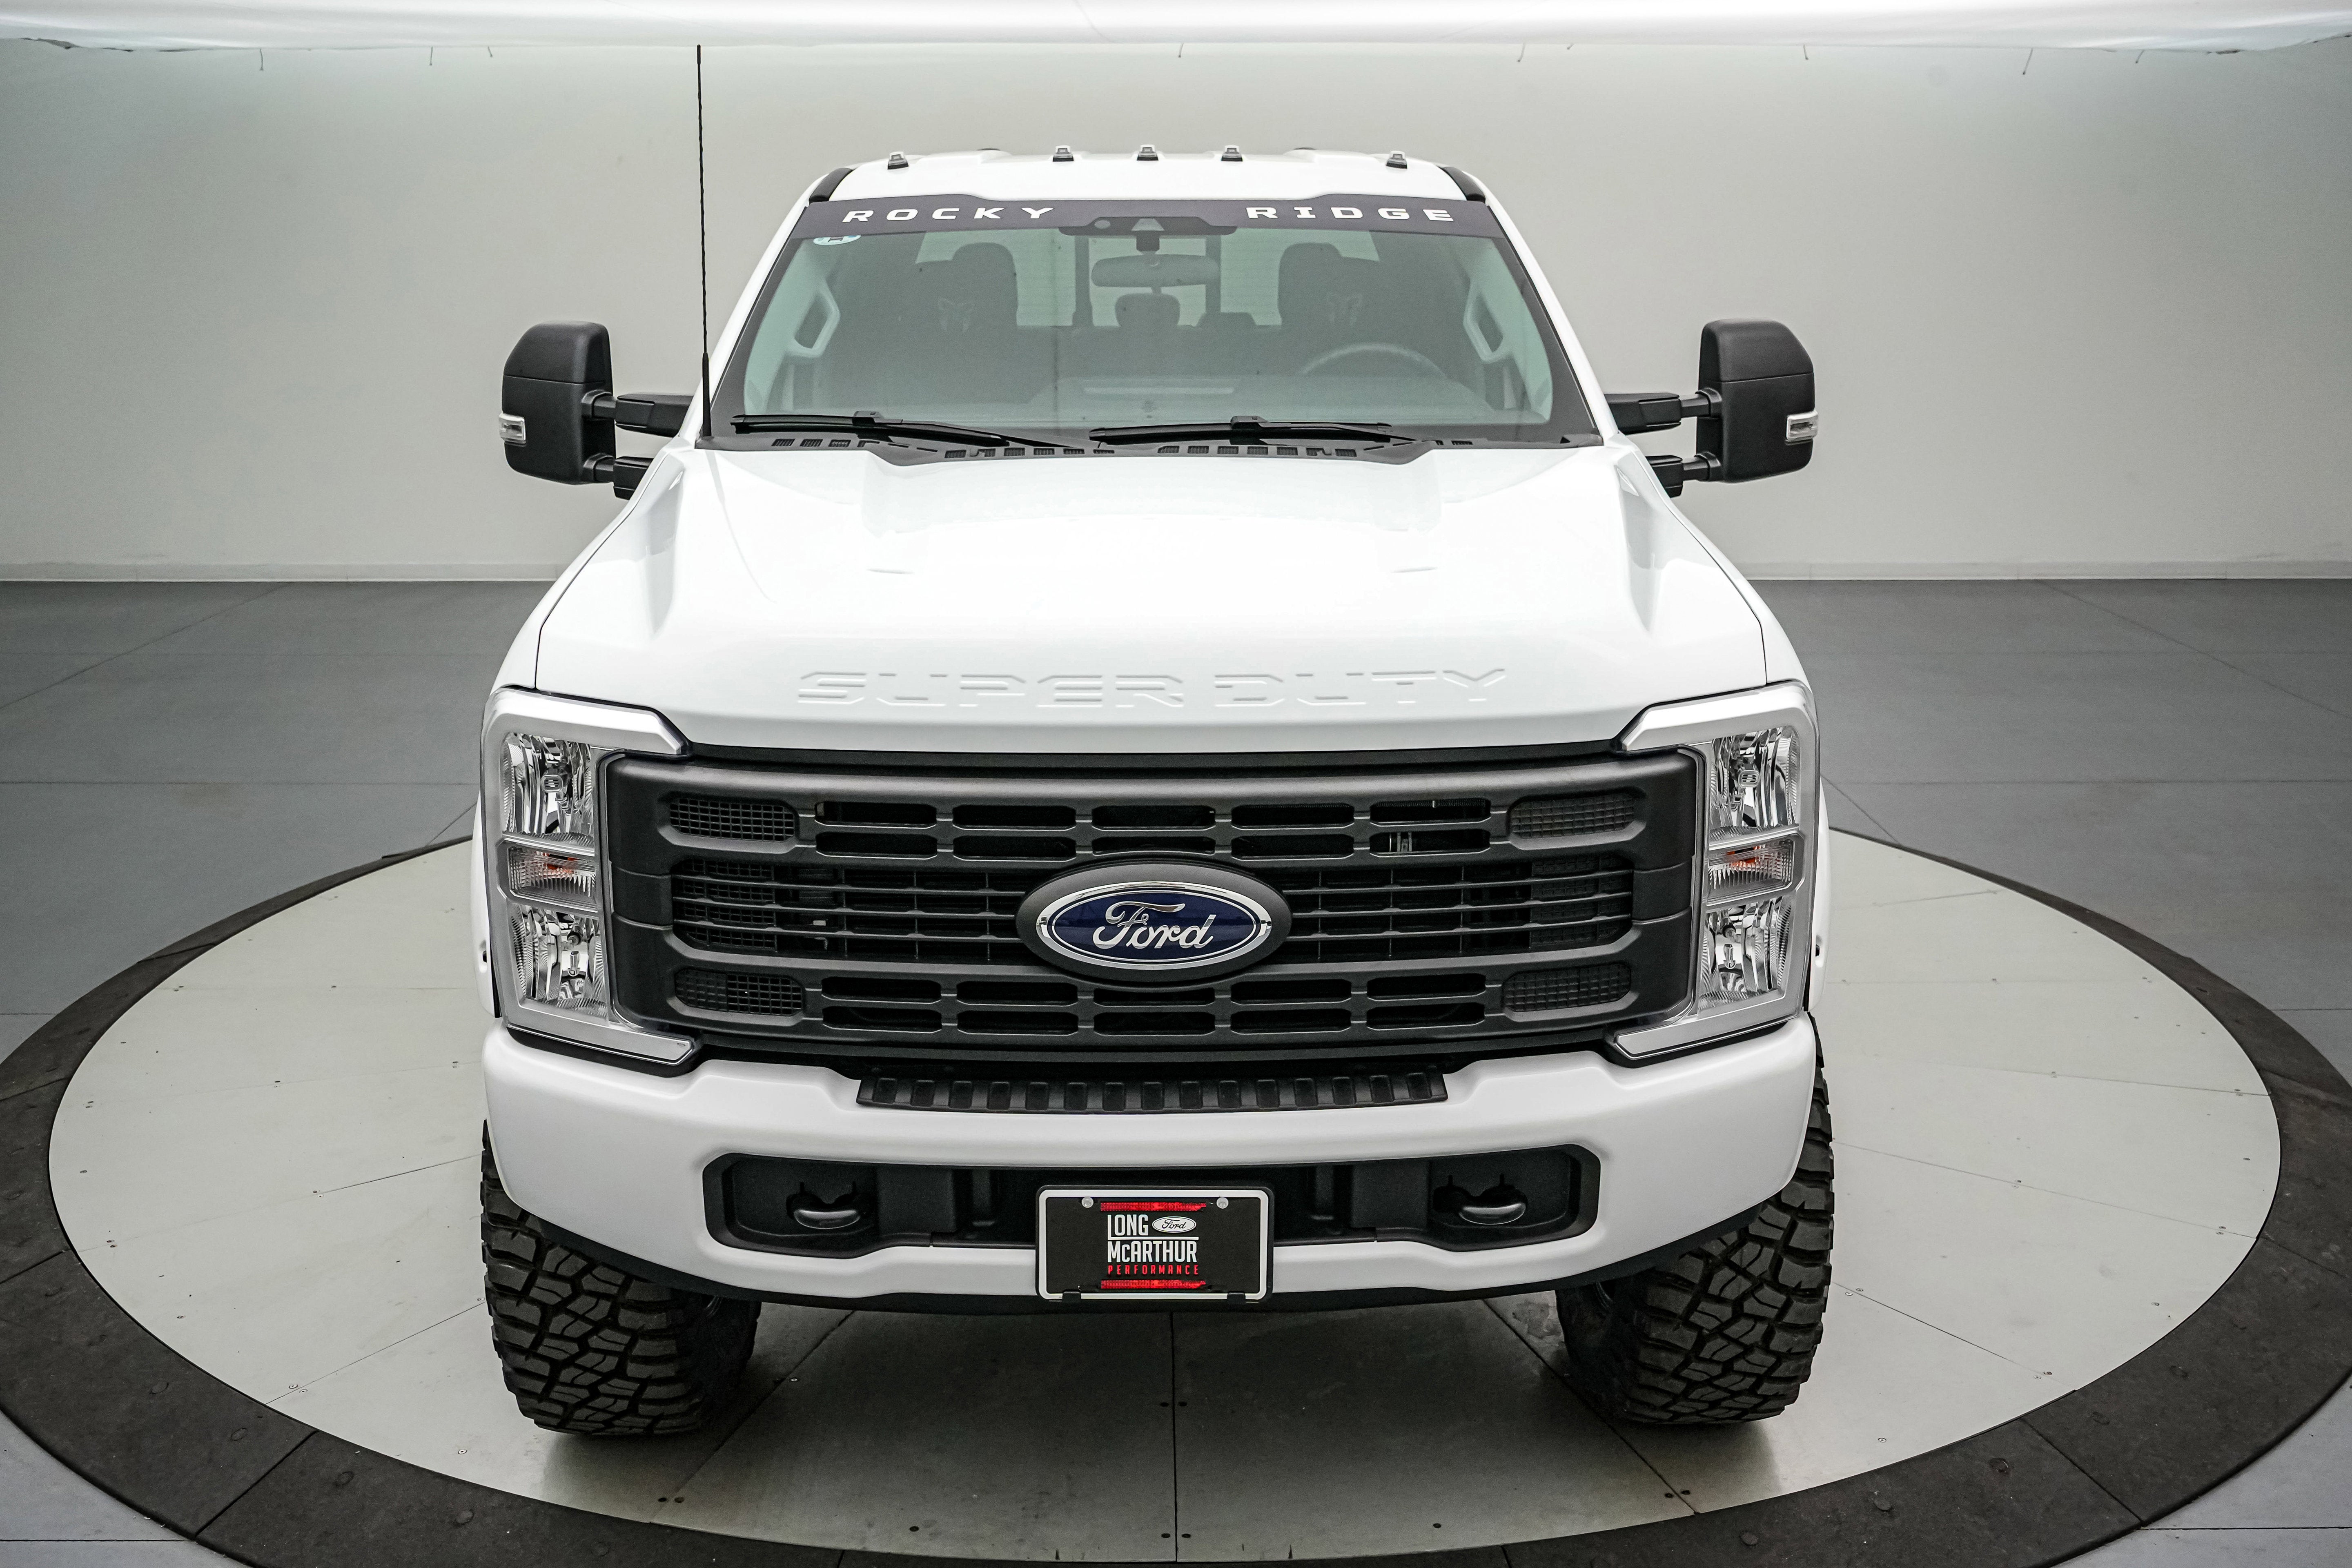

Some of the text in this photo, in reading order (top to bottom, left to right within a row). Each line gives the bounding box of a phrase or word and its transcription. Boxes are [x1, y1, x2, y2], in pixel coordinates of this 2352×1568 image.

[842, 207, 1454, 222] ROCKY RIDGE
[796, 668, 1507, 708] SUPER DUTY
[1093, 901, 1217, 949] Ford
[1107, 1214, 1187, 1240] LONG Ford
[1107, 1241, 1197, 1263] McARTHUR
[1108, 1265, 1198, 1274] PERFORMANCE
